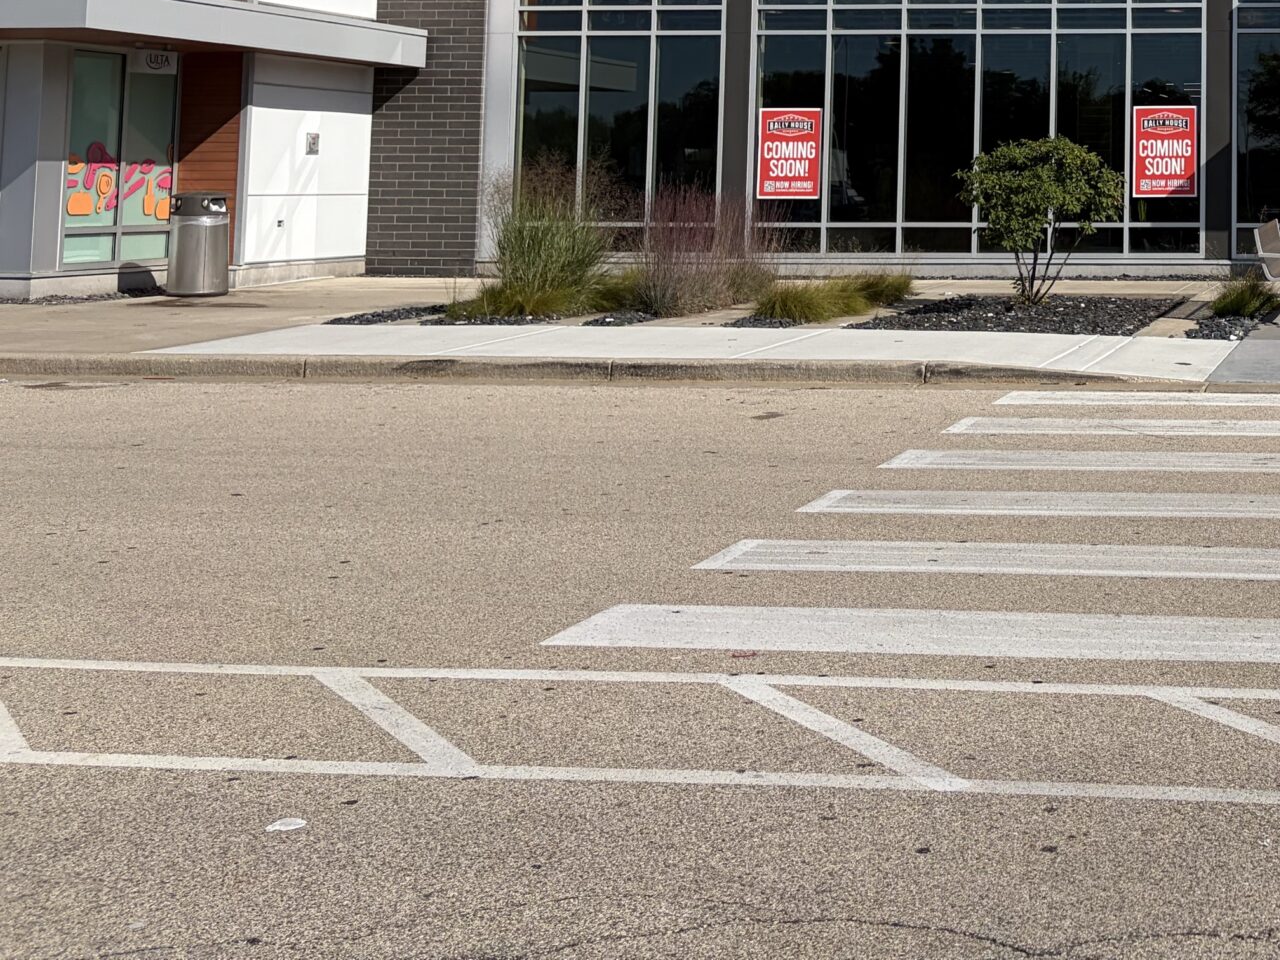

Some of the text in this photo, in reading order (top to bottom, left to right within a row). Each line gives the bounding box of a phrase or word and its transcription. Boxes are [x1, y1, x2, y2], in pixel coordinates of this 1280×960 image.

[146, 51, 170, 69] ULTA
[770, 121, 812, 131] RALLY HOUSE
[1144, 120, 1186, 129] RALLY HOUSE
[764, 141, 816, 159] COMING
[1139, 139, 1192, 157] COMING
[769, 160, 809, 177] SOON!
[1145, 158, 1185, 176] SOON!
[776, 181, 813, 189] NOW HIRING!
[1152, 179, 1190, 187] NOW HIRING!
